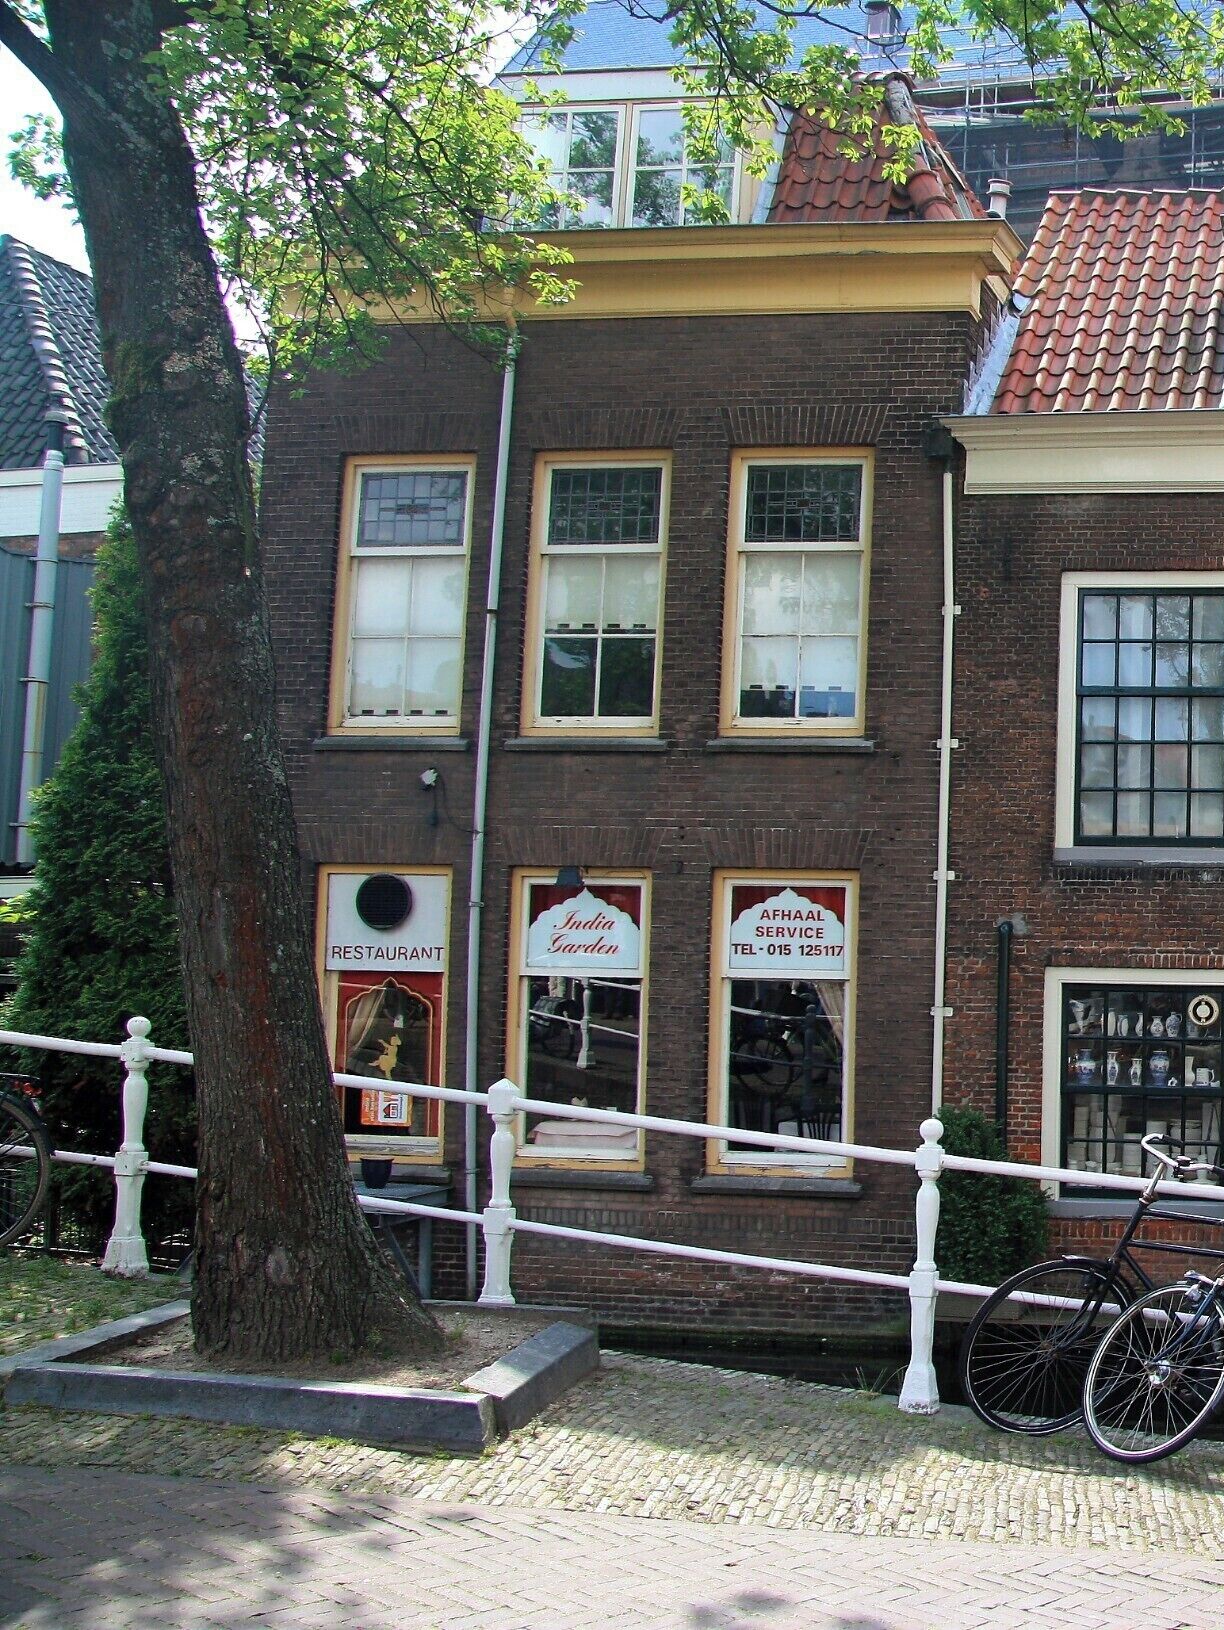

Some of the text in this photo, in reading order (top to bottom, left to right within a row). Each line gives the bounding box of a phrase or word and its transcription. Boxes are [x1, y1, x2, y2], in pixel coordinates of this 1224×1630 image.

[553, 910, 615, 931] India
[760, 909, 825, 921] AFHAAL
[755, 926, 824, 939] SERVICE
[547, 933, 620, 955] Garden
[766, 943, 792, 956] 015
[798, 944, 844, 957] 125117
[331, 945, 445, 961] RESTAURANT
